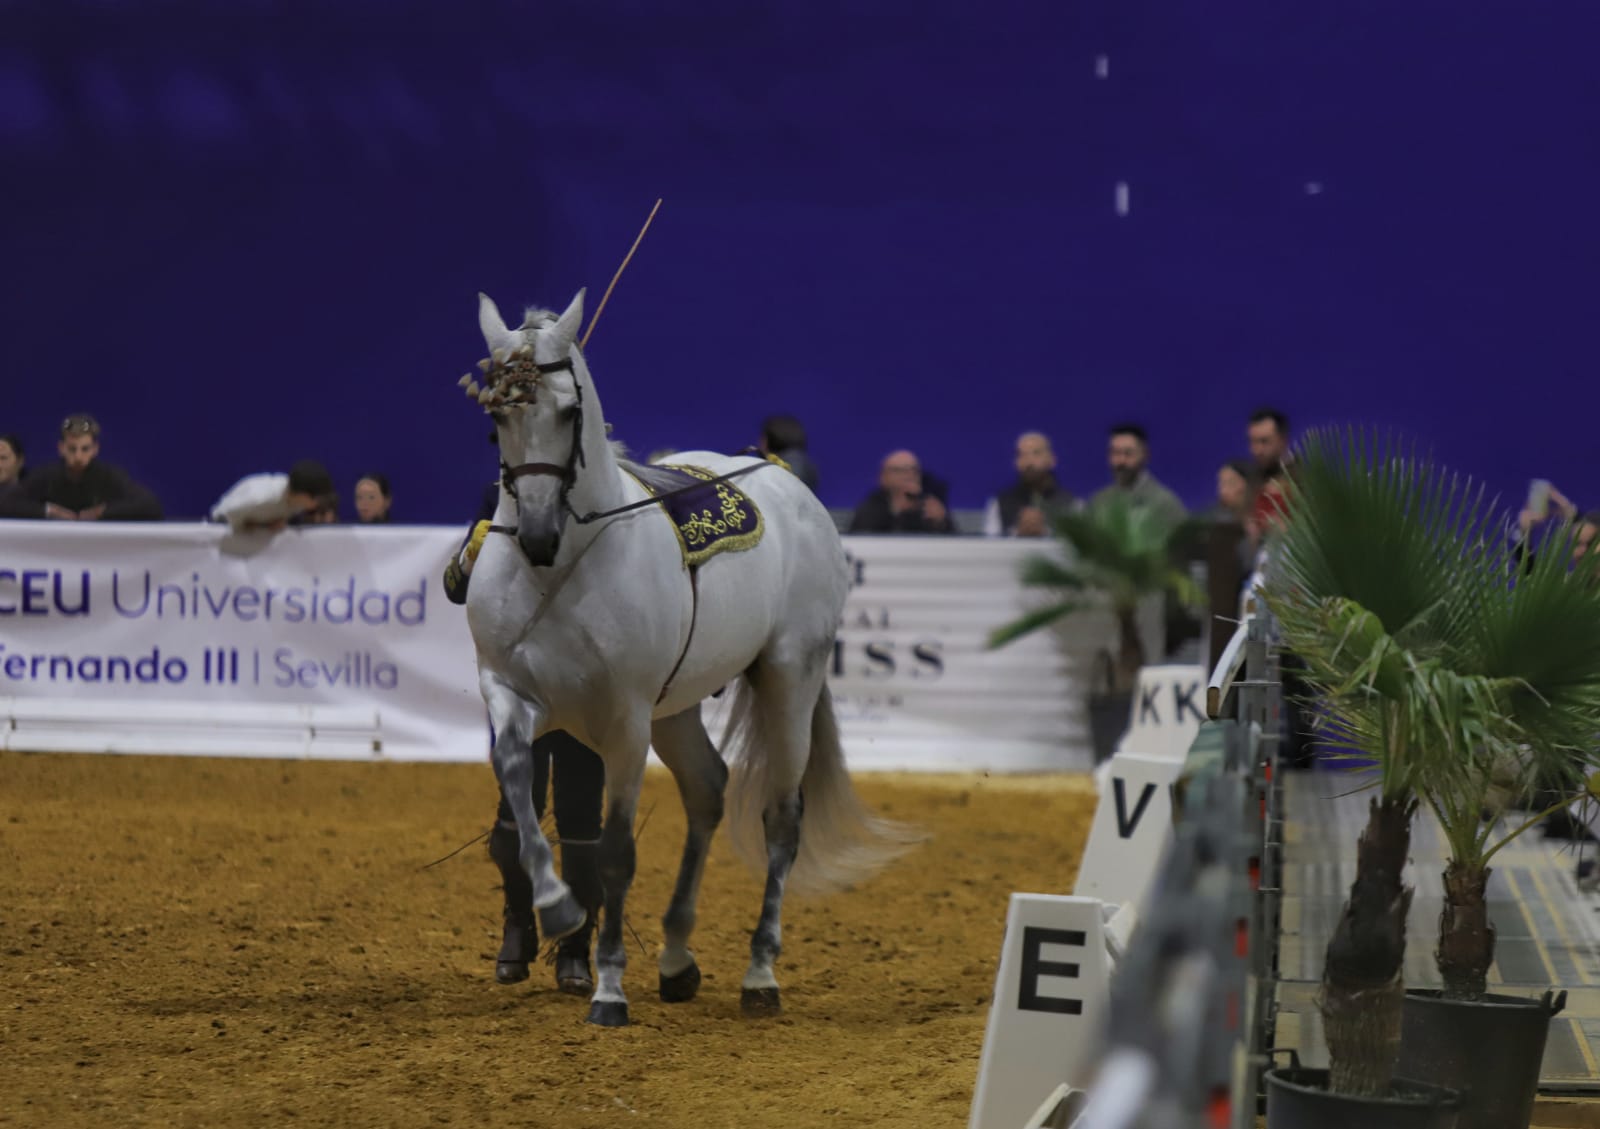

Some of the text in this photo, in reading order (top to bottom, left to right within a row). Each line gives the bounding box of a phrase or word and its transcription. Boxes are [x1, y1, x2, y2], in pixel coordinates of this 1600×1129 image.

[112, 570, 427, 626] Universidad
[0, 645, 398, 690] ernando III Sevilla
[1173, 682, 1207, 723] K
[1113, 776, 1158, 839] V
[1018, 926, 1086, 1015] E
